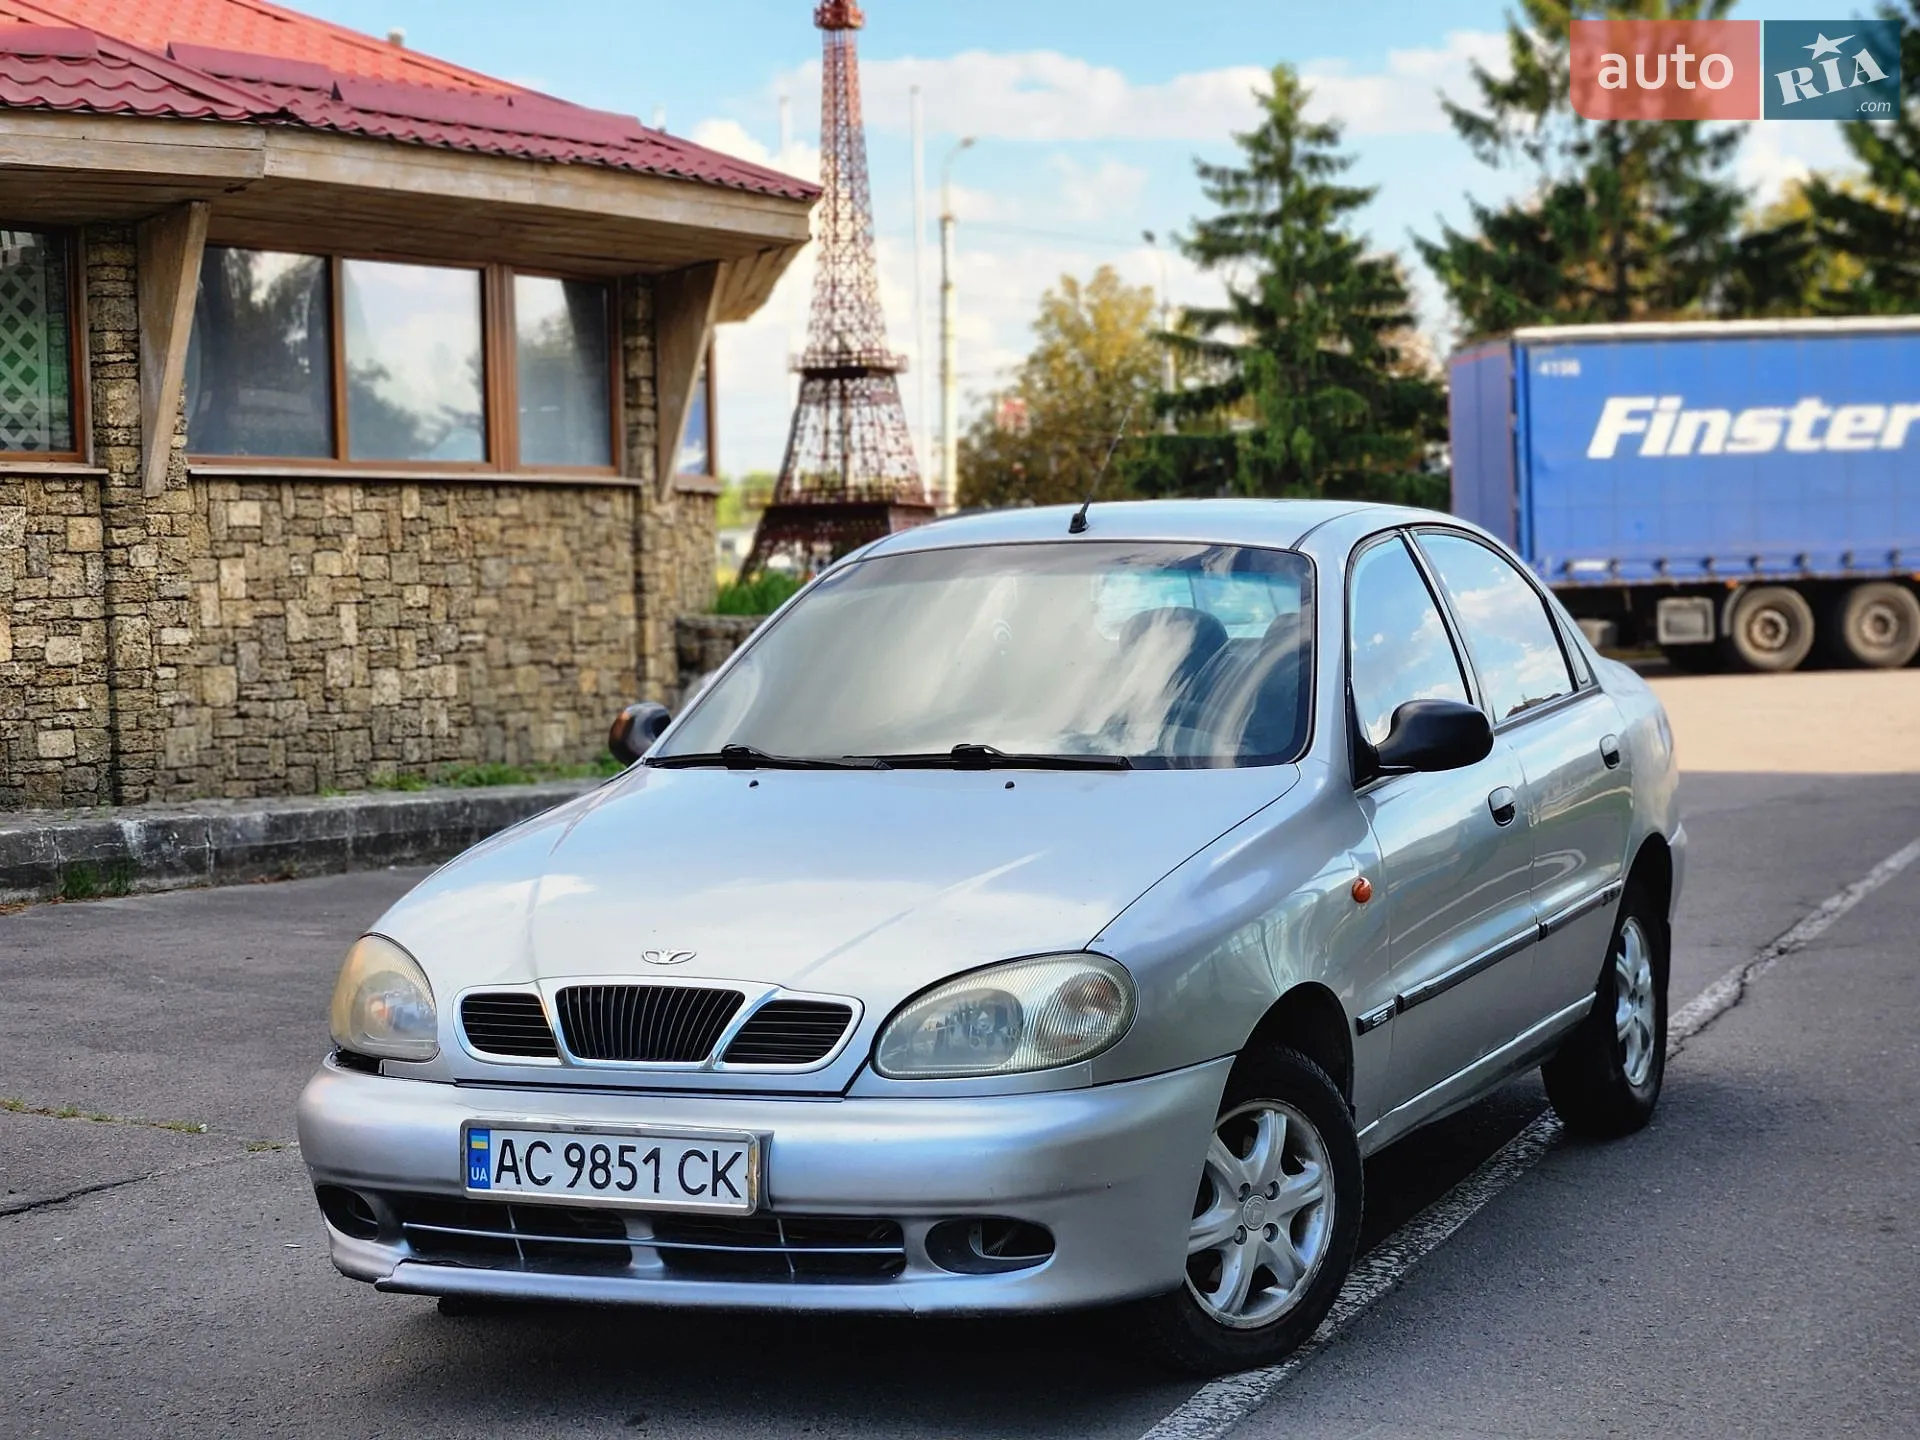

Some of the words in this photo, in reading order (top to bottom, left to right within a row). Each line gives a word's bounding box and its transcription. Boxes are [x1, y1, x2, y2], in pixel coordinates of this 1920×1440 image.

[1372, 1009, 1388, 1027] SE
[471, 1167, 488, 1182] UA
[494, 1139, 553, 1186] AC
[564, 1142, 661, 1194] 9851
[678, 1149, 743, 1198] CK
